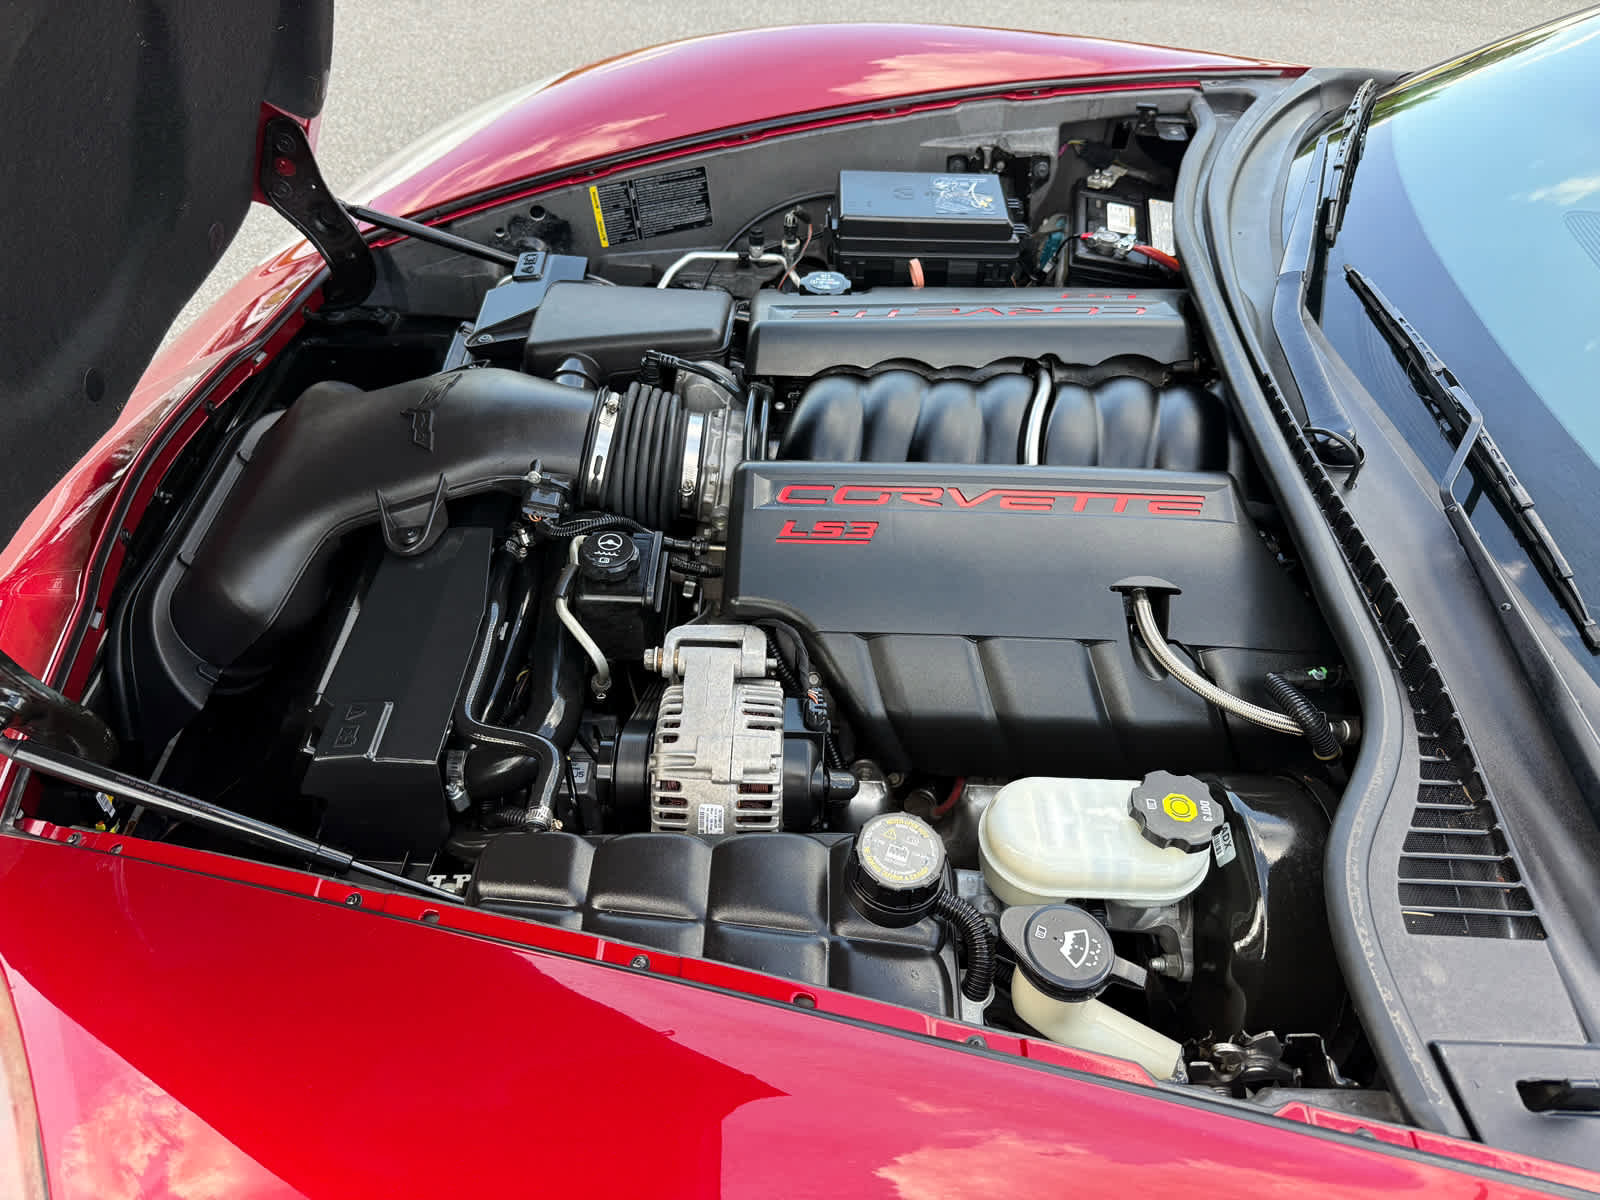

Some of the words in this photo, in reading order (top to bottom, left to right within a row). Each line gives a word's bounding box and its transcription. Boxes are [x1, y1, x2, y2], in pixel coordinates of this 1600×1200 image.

[776, 484, 1205, 516] CORVETTE
[778, 520, 879, 538] LS3
[1221, 826, 1232, 849] ADX
